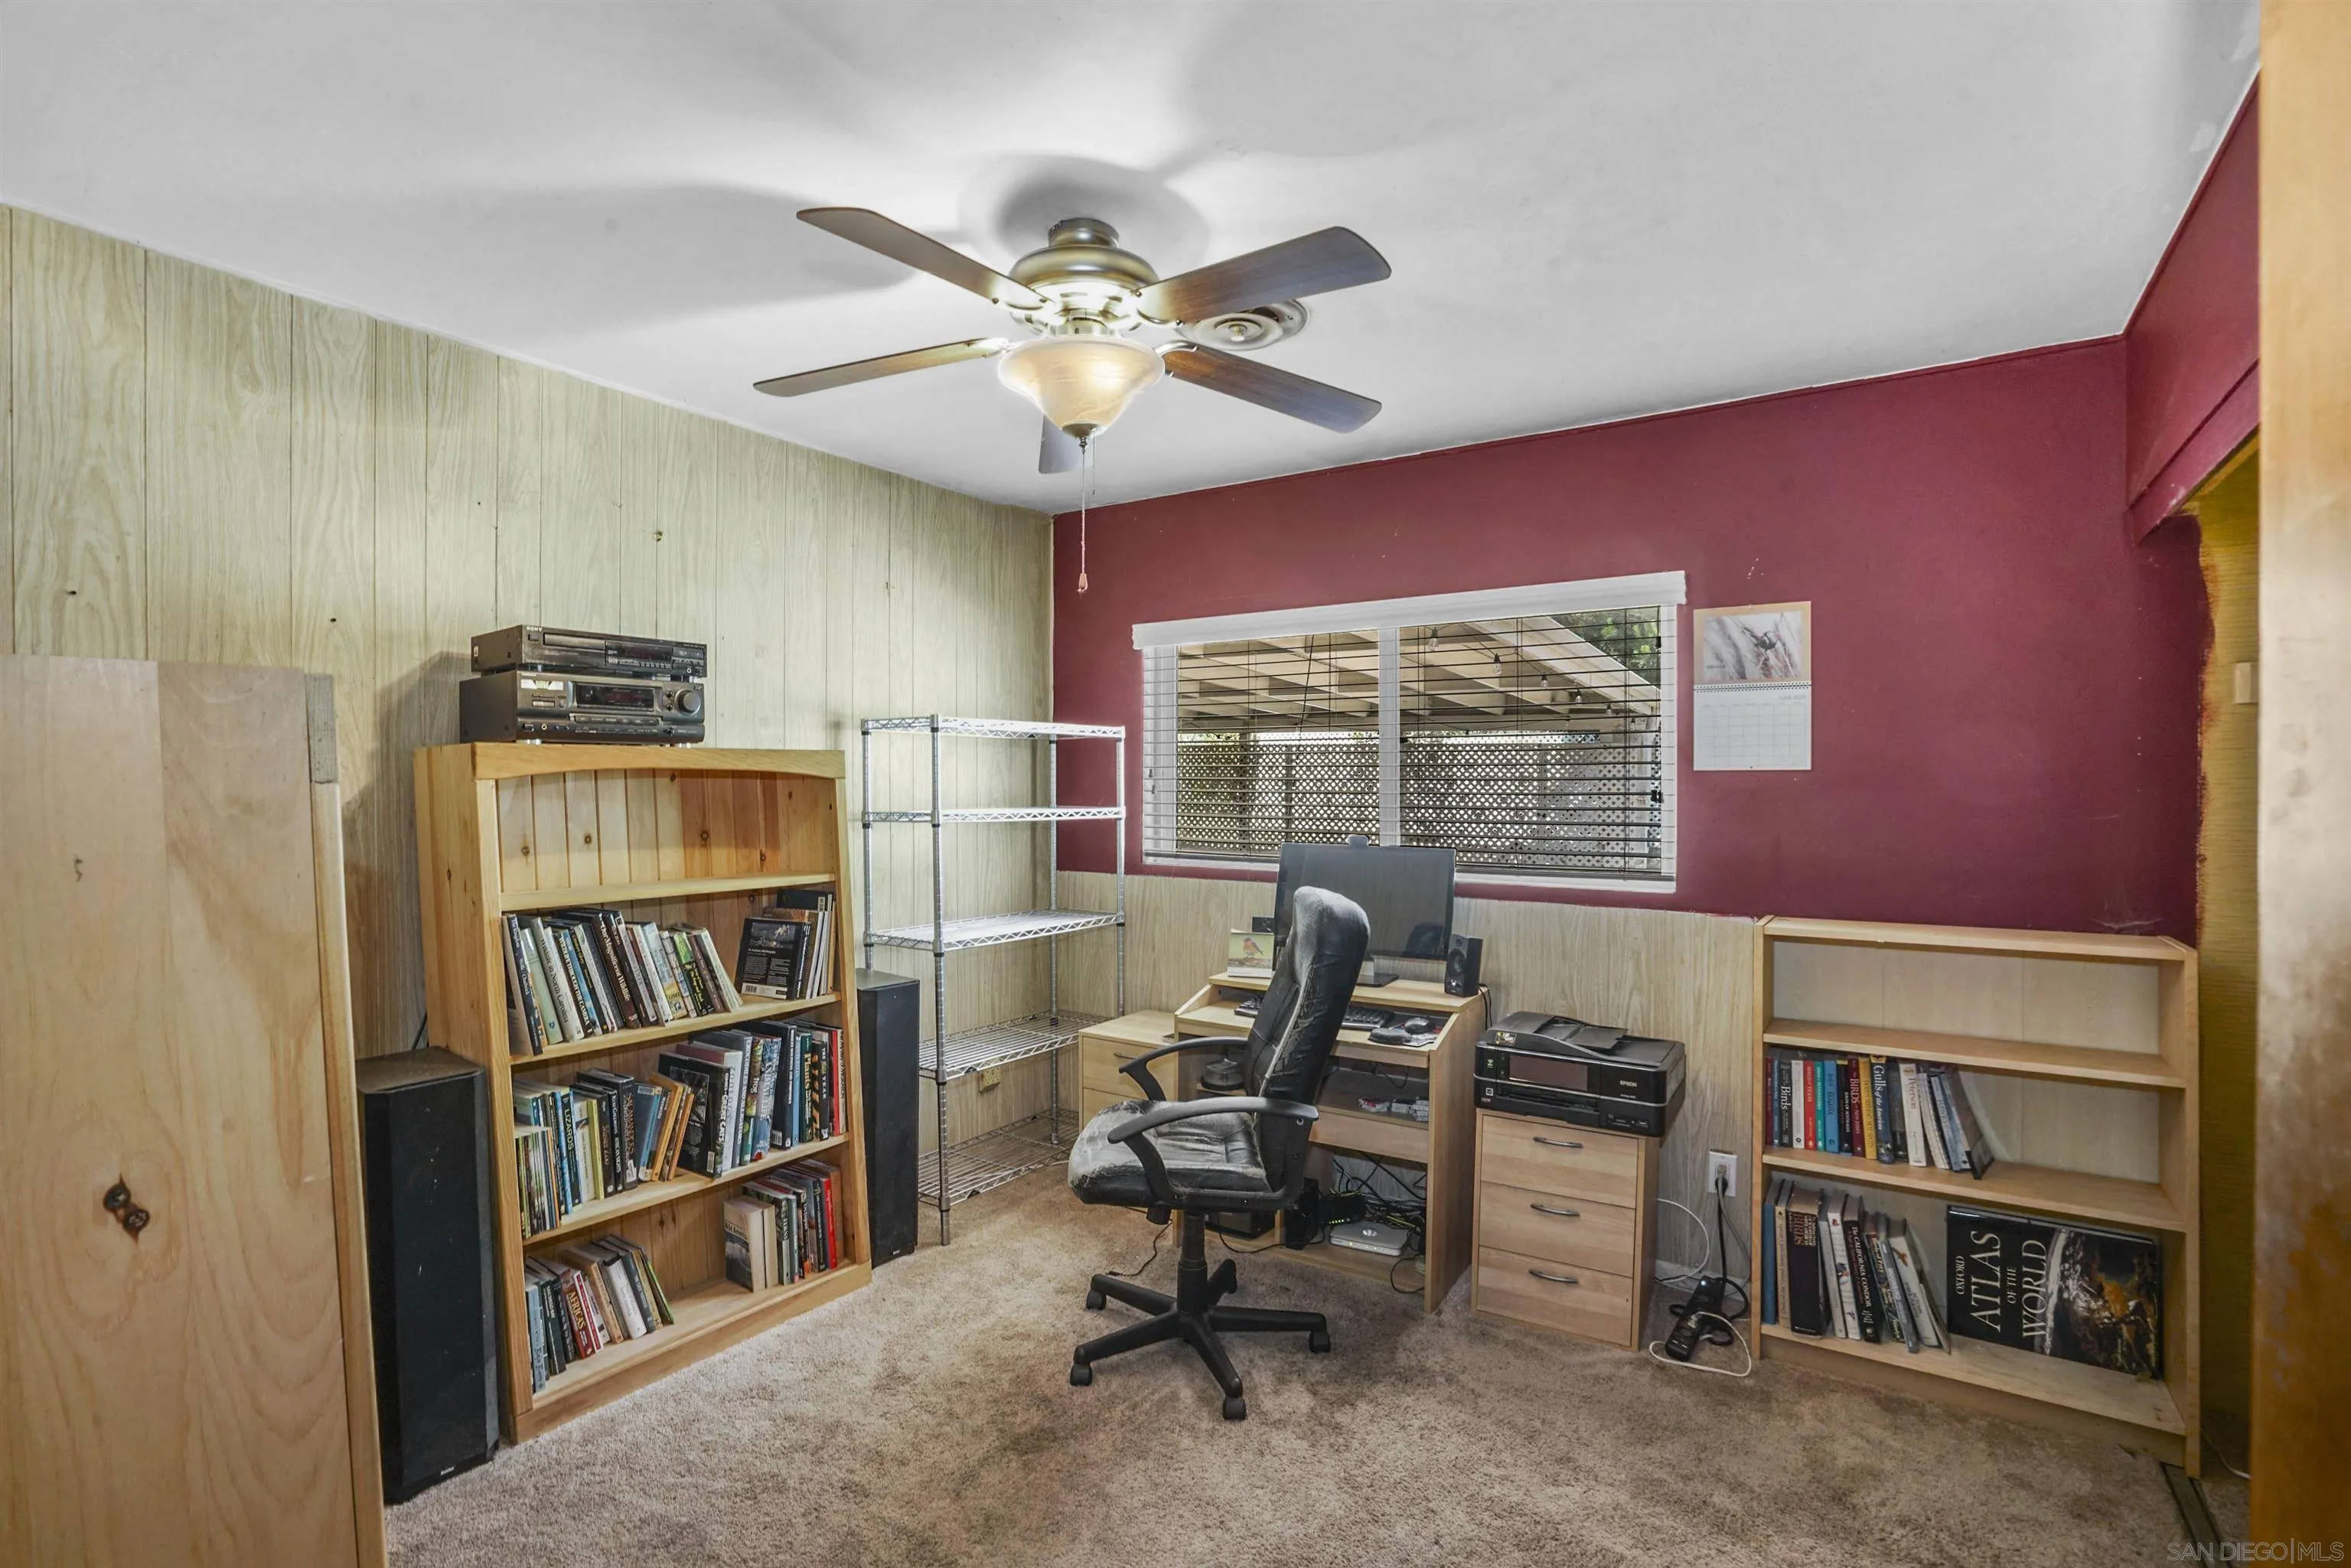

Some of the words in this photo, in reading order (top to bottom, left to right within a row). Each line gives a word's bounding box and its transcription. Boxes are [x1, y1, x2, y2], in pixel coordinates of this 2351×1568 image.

[600, 924, 609, 938] Our
[541, 940, 551, 964] Wildlife
[604, 937, 621, 977] Magnificent
[548, 964, 553, 973] in
[550, 973, 560, 994] North
[618, 975, 631, 1002] Wildlife
[558, 995, 569, 1023] Carolina
[579, 1000, 589, 1025] CAMERA
[750, 1077, 760, 1094] frog
[763, 1061, 772, 1096] ANIMAL
[1850, 1078, 1860, 1103] BIRDS
[1873, 1064, 1886, 1091] Gulls
[1781, 1086, 1791, 1110] Birds
[1908, 1077, 1916, 1109] Peterson
[760, 1098, 768, 1120] LIFE
[564, 1109, 573, 1150] LIZARDS
[627, 1093, 635, 1155] SALAMANDERS
[1793, 1212, 1804, 1245] BIRDS
[1854, 1237, 1864, 1276] CALIFORNIA
[1861, 1276, 1871, 1307] CONDOR
[1955, 1255, 1966, 1296] OXFORD
[1970, 1231, 2000, 1333] ATLAS
[2006, 1266, 2017, 1286] THE
[2007, 1289, 2017, 1304] OF
[2022, 1240, 2047, 1338] WORLD
